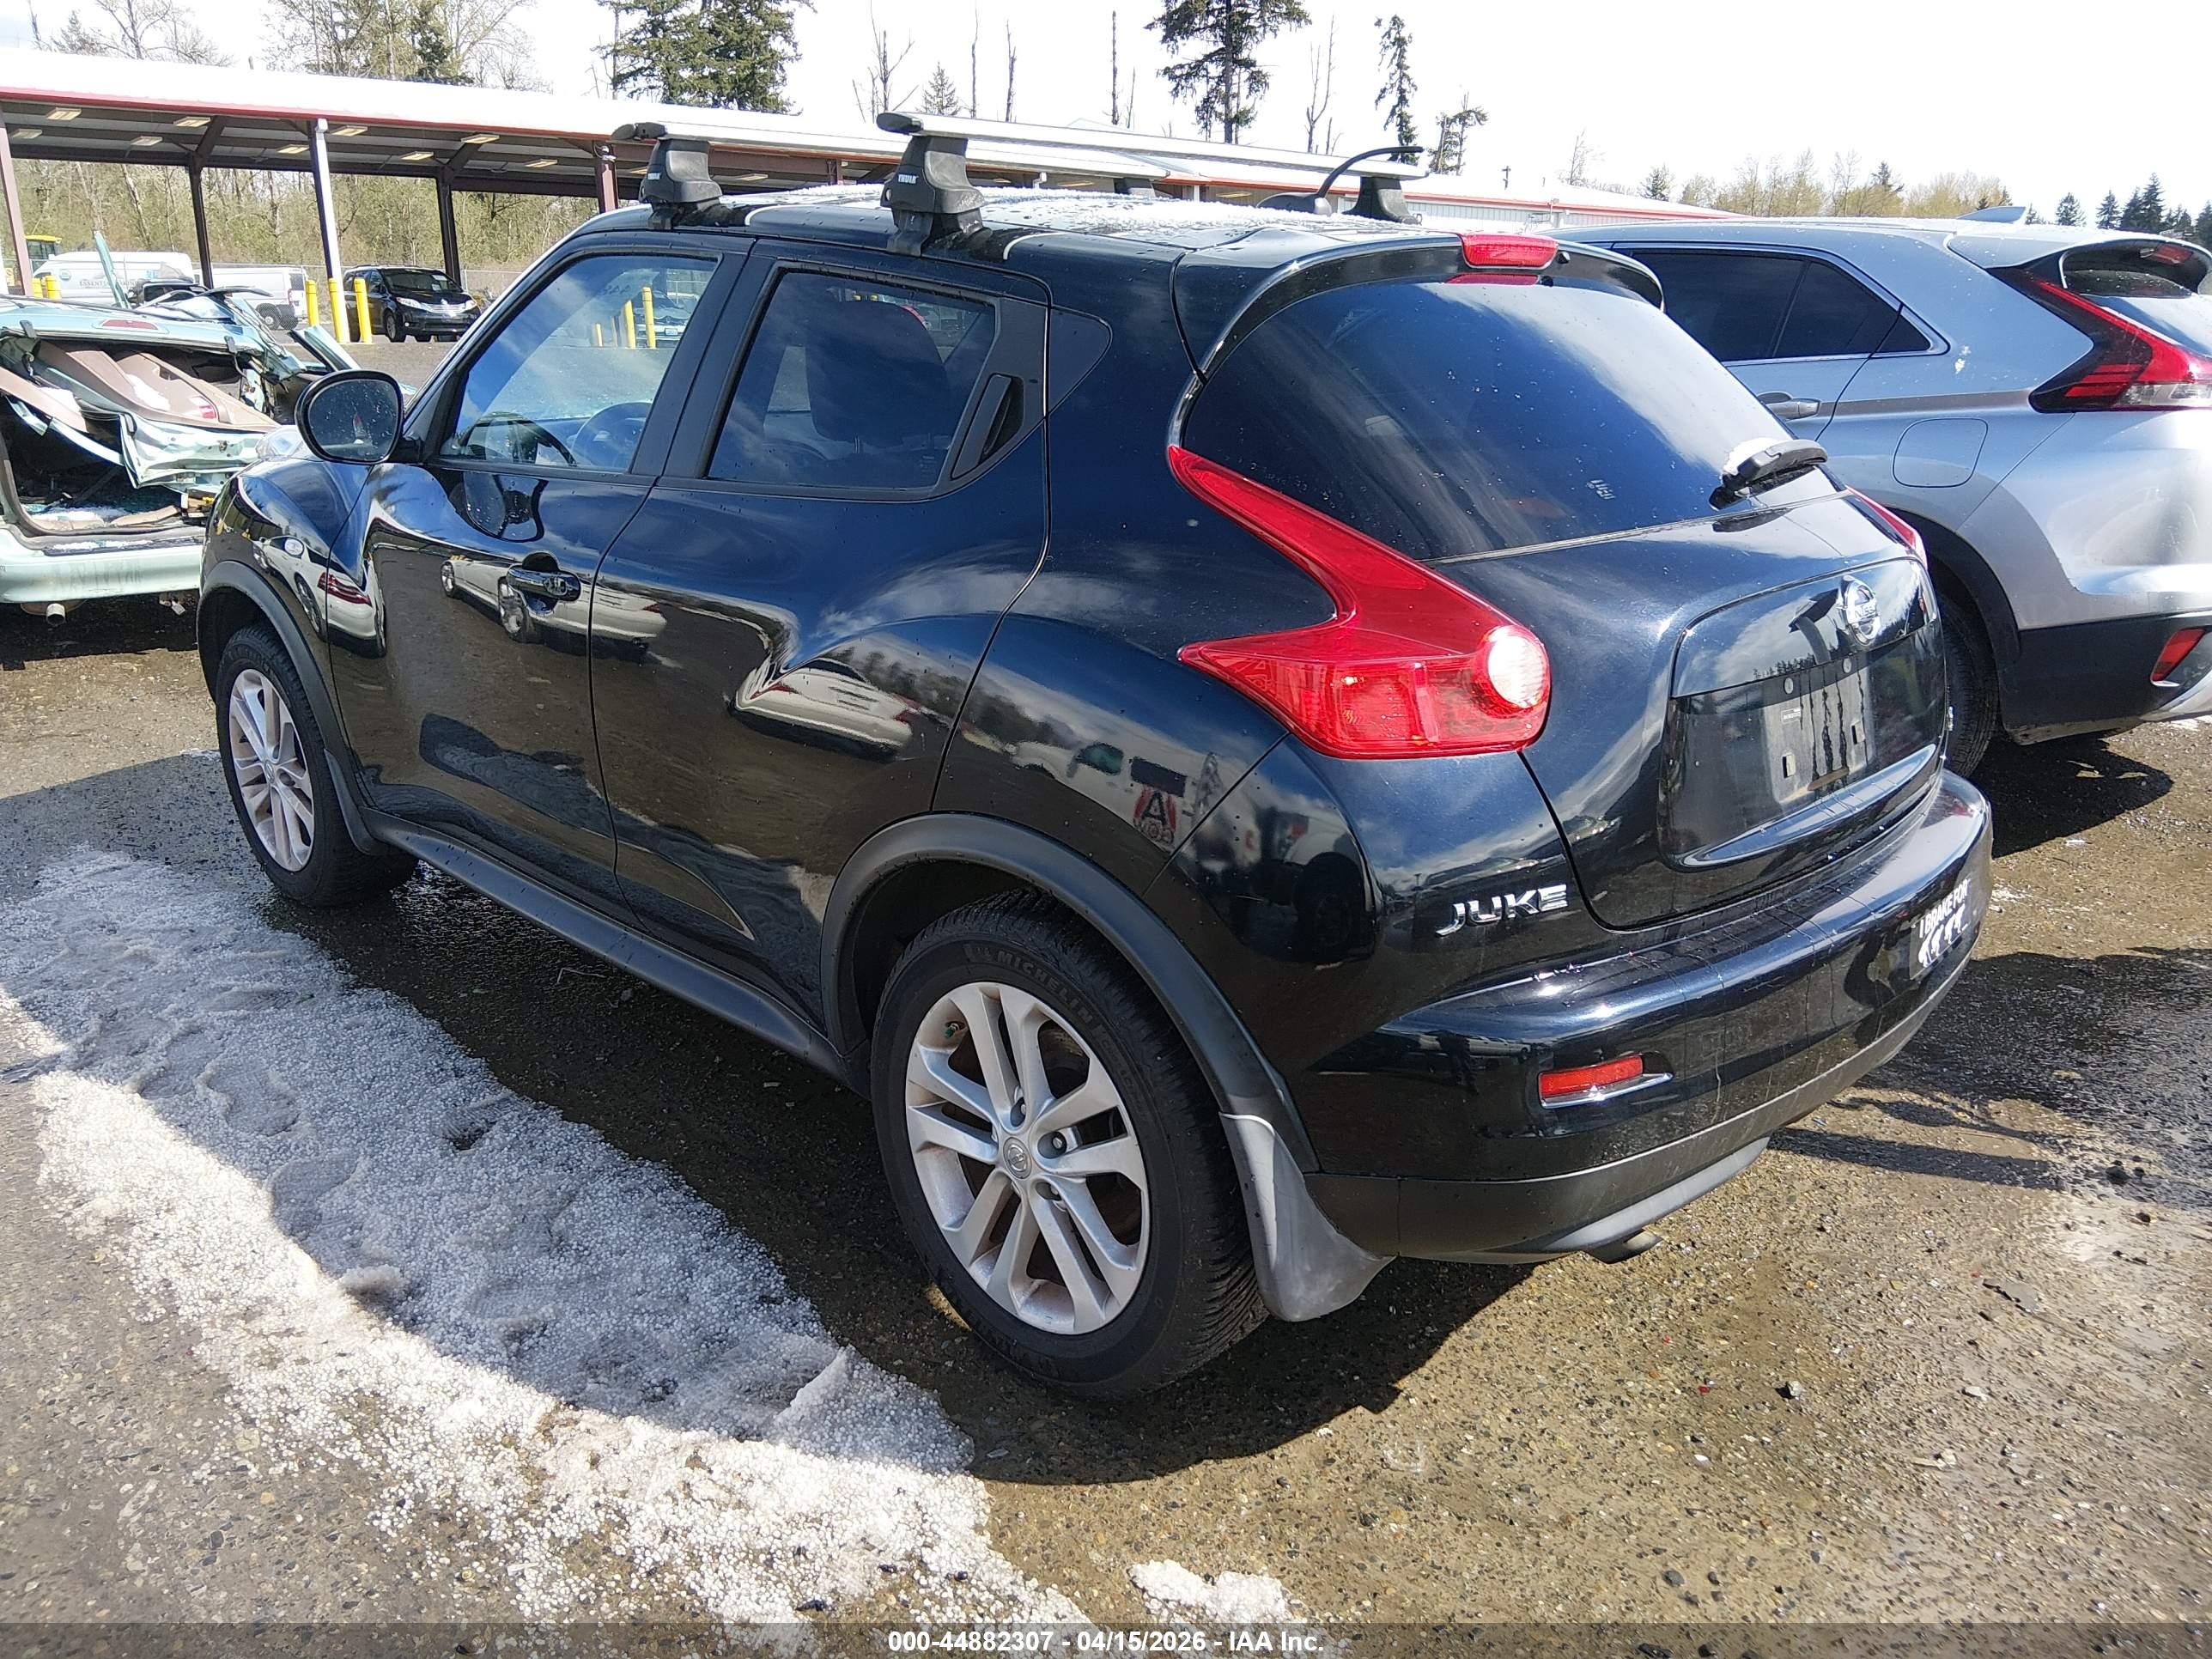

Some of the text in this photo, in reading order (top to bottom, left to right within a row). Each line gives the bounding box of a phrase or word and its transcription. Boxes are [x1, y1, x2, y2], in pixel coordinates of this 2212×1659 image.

[1436, 884, 1568, 937] JUKE
[1924, 894, 1954, 934] BRAKE
[1953, 878, 1968, 908] FOR
[997, 950, 1093, 1024] MICHELIN
